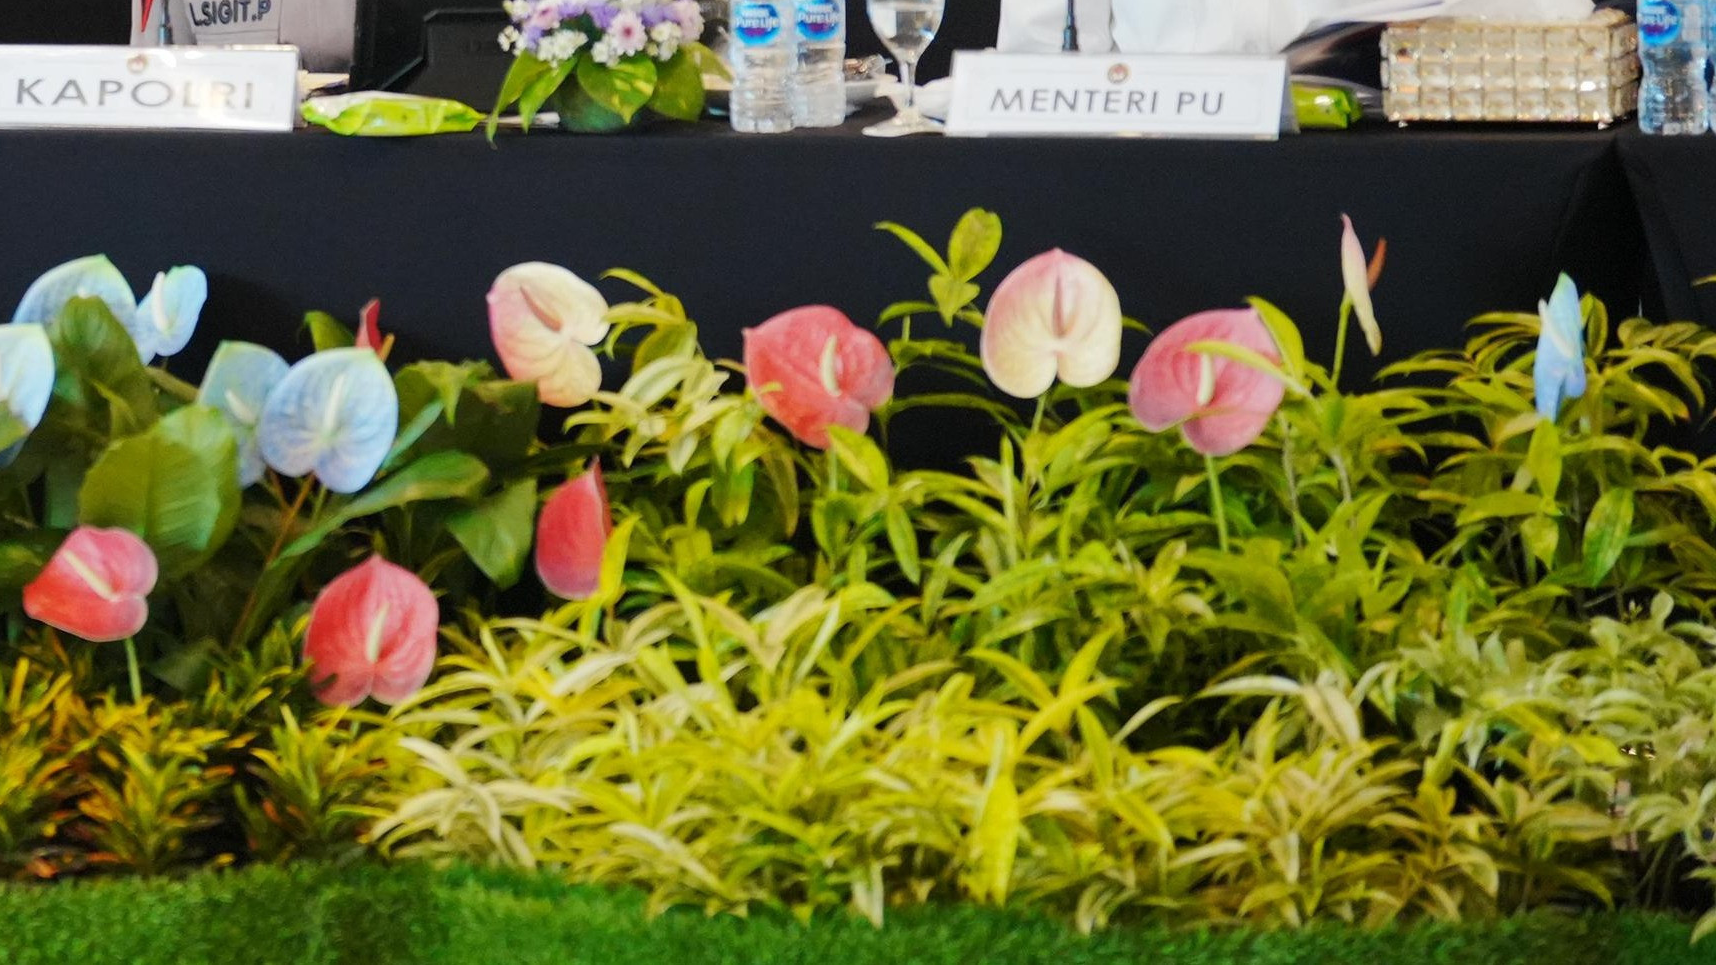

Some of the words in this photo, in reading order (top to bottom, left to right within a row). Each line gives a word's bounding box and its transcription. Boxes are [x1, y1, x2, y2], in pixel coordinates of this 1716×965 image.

[16, 78, 254, 109] KAPOLRI
[989, 88, 1160, 114] MENTERI
[1176, 91, 1225, 116] PU
